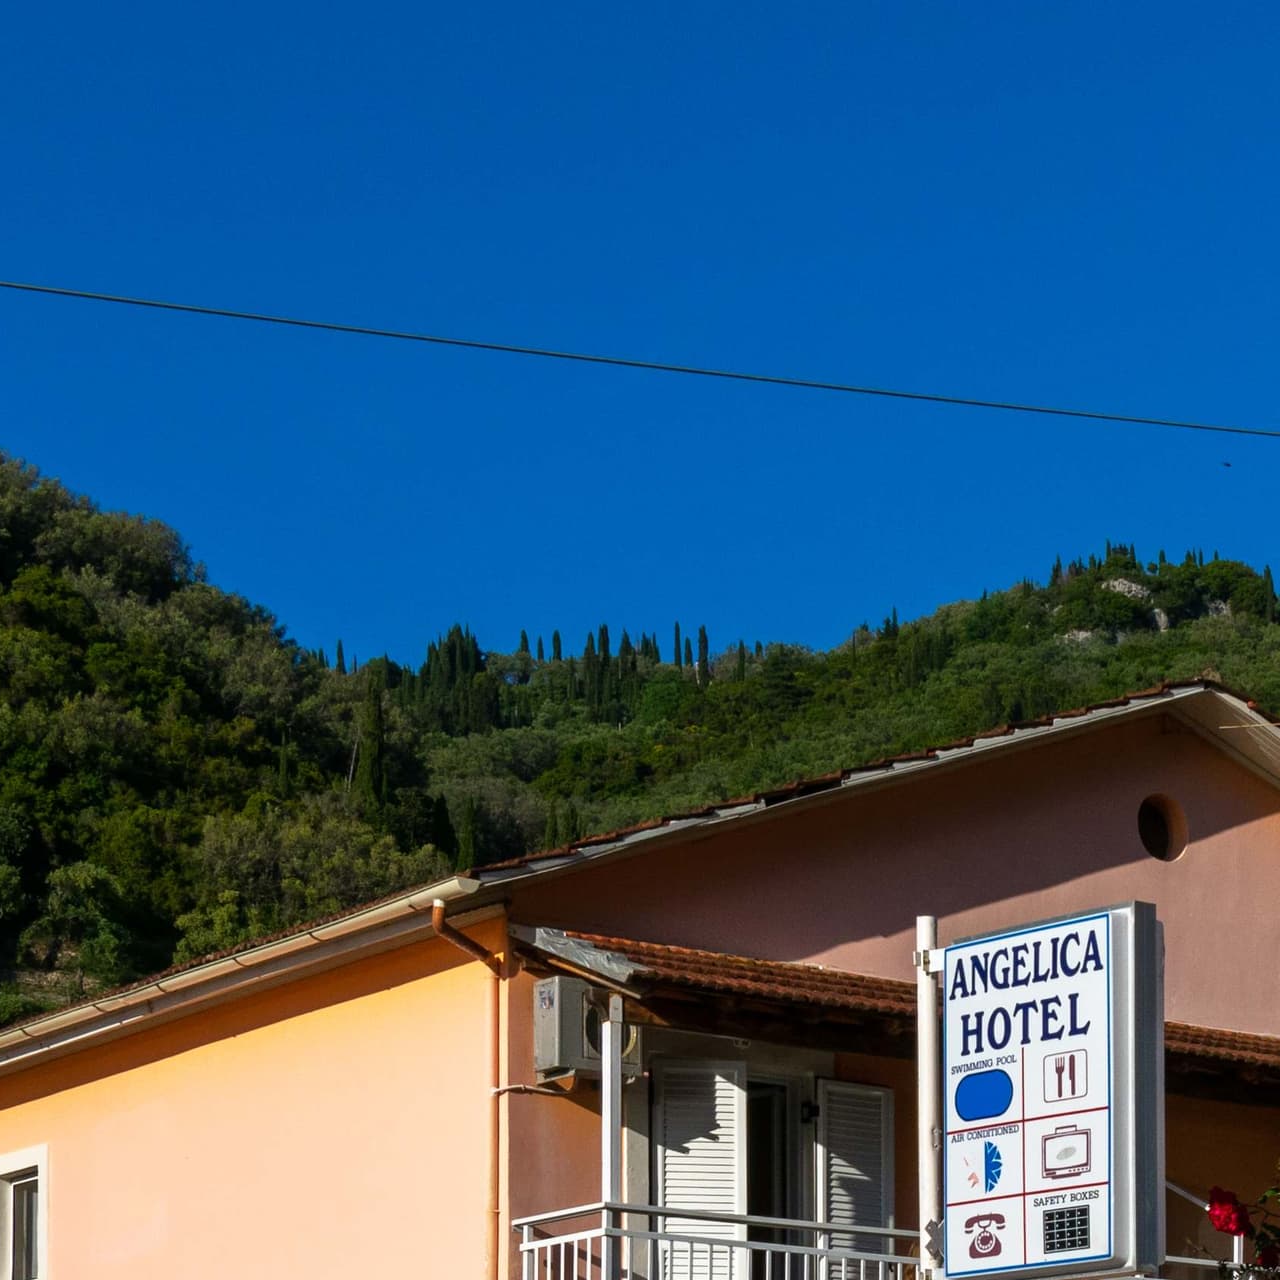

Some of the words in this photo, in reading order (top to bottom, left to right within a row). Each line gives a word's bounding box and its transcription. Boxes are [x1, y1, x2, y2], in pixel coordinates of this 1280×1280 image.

[949, 929, 1104, 1000] ANGELICA
[960, 993, 1091, 1056] HOTEL
[951, 1057, 993, 1075] SWIMMING
[996, 1054, 1017, 1067] POOL
[951, 1132, 965, 1144] AIR
[967, 1124, 1020, 1141] CONDITIONED
[1033, 1193, 1068, 1207] SAFETY
[1070, 1190, 1100, 1202] BOXES
